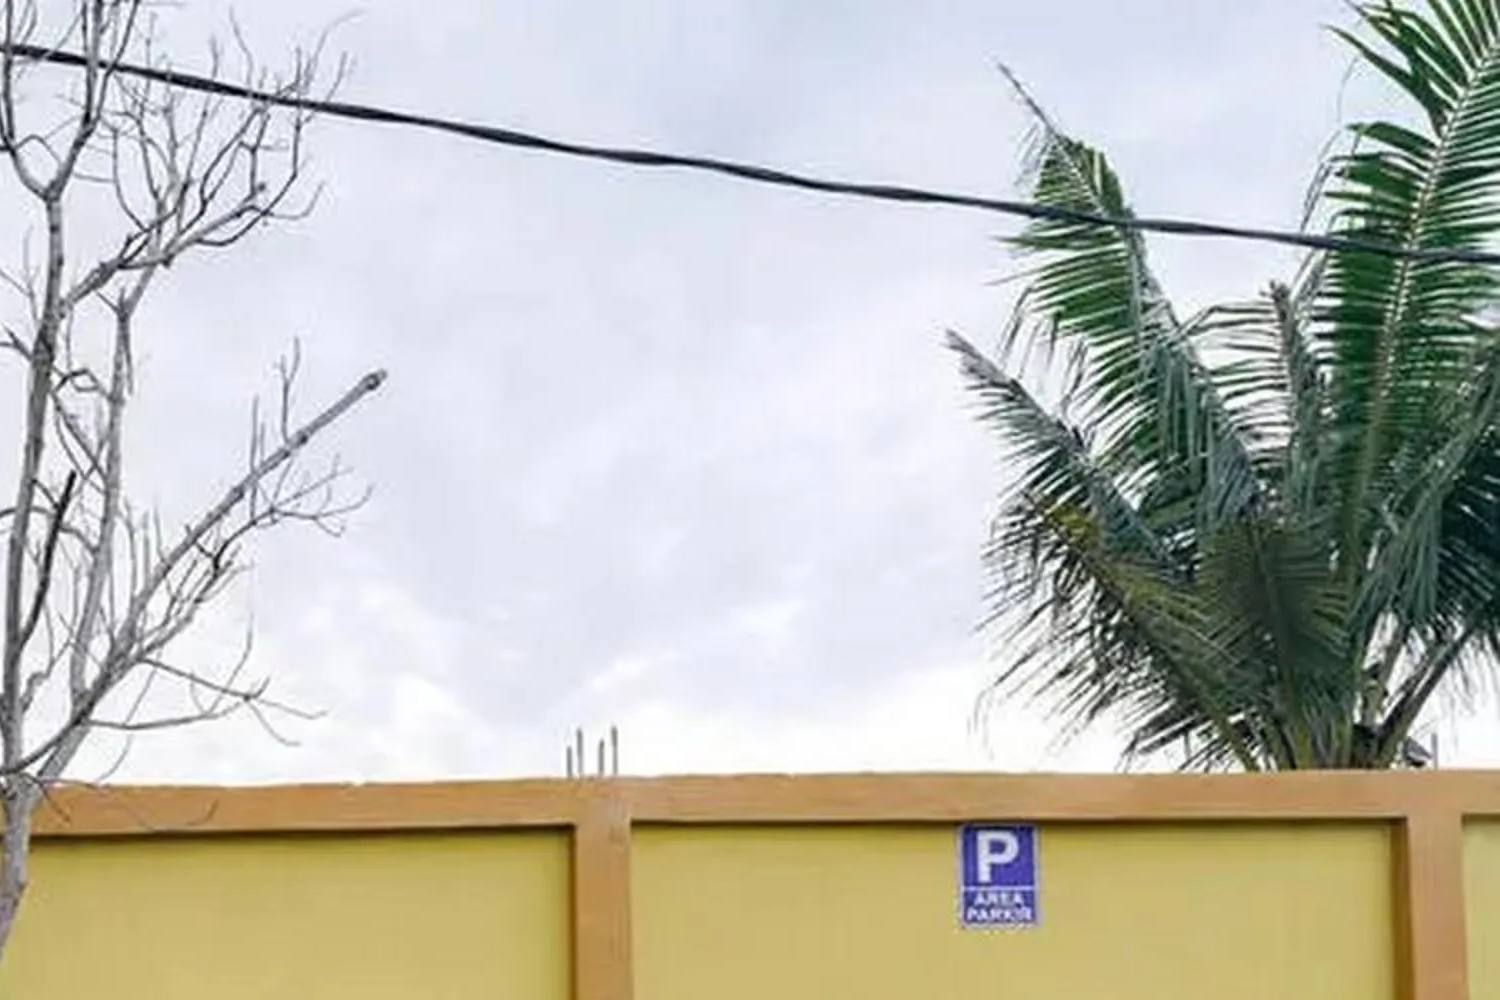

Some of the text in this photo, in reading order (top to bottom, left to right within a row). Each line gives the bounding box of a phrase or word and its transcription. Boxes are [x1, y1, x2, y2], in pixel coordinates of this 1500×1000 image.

[977, 830, 1020, 883] P
[974, 891, 1025, 906] AREA
[966, 907, 1032, 921] PARKIR
